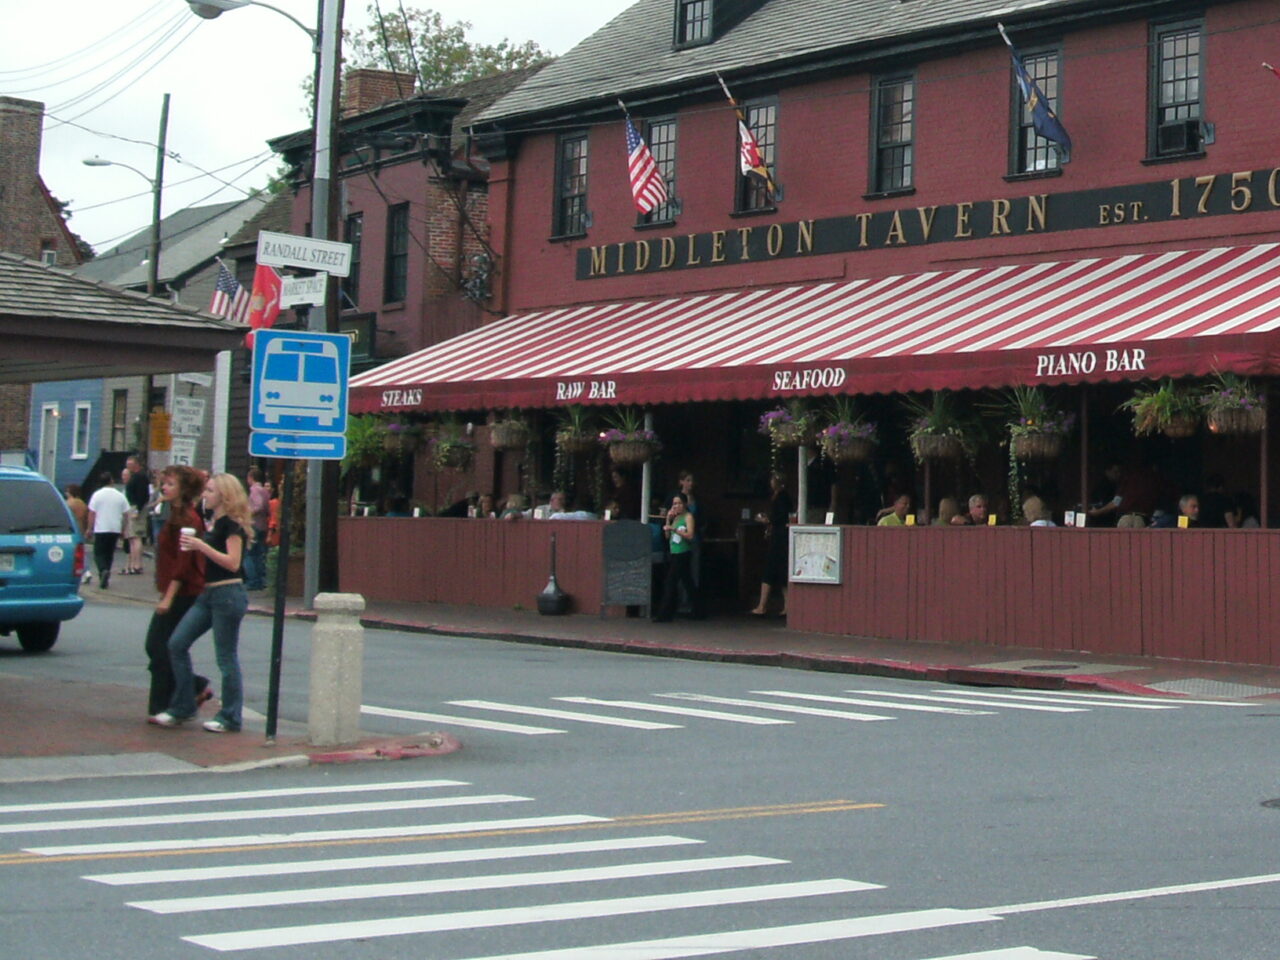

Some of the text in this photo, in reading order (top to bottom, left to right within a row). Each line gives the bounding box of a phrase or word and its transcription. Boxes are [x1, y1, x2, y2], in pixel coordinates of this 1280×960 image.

[590, 220, 815, 276] MIDDLETON
[856, 194, 1048, 247] TAVERN
[1099, 201, 1149, 225] EST.
[262, 241, 346, 267] RANDALL STREET
[1035, 348, 1146, 377] PIANO BAR
[556, 380, 616, 401] RAW BAR
[772, 367, 846, 390] SEAFOOD
[380, 389, 423, 407] STEAKS
